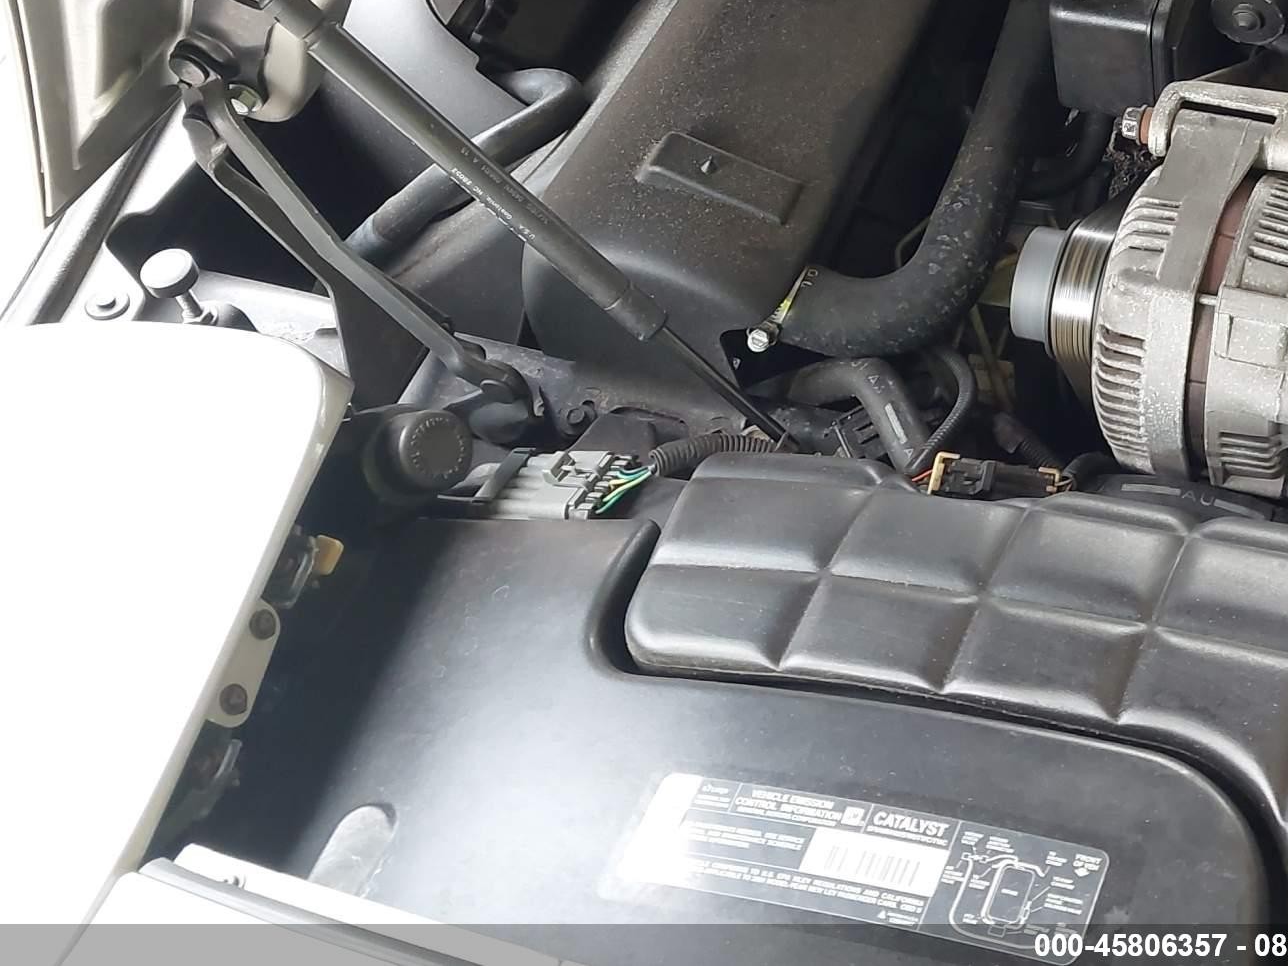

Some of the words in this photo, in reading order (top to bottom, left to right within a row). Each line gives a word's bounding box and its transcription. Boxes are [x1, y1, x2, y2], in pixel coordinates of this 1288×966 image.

[735, 796, 777, 810] CONTROL
[779, 804, 842, 820] INFORMATION
[751, 789, 791, 803] VEHICLE
[789, 795, 835, 809] EMISSION
[873, 811, 950, 837] CATALYST
